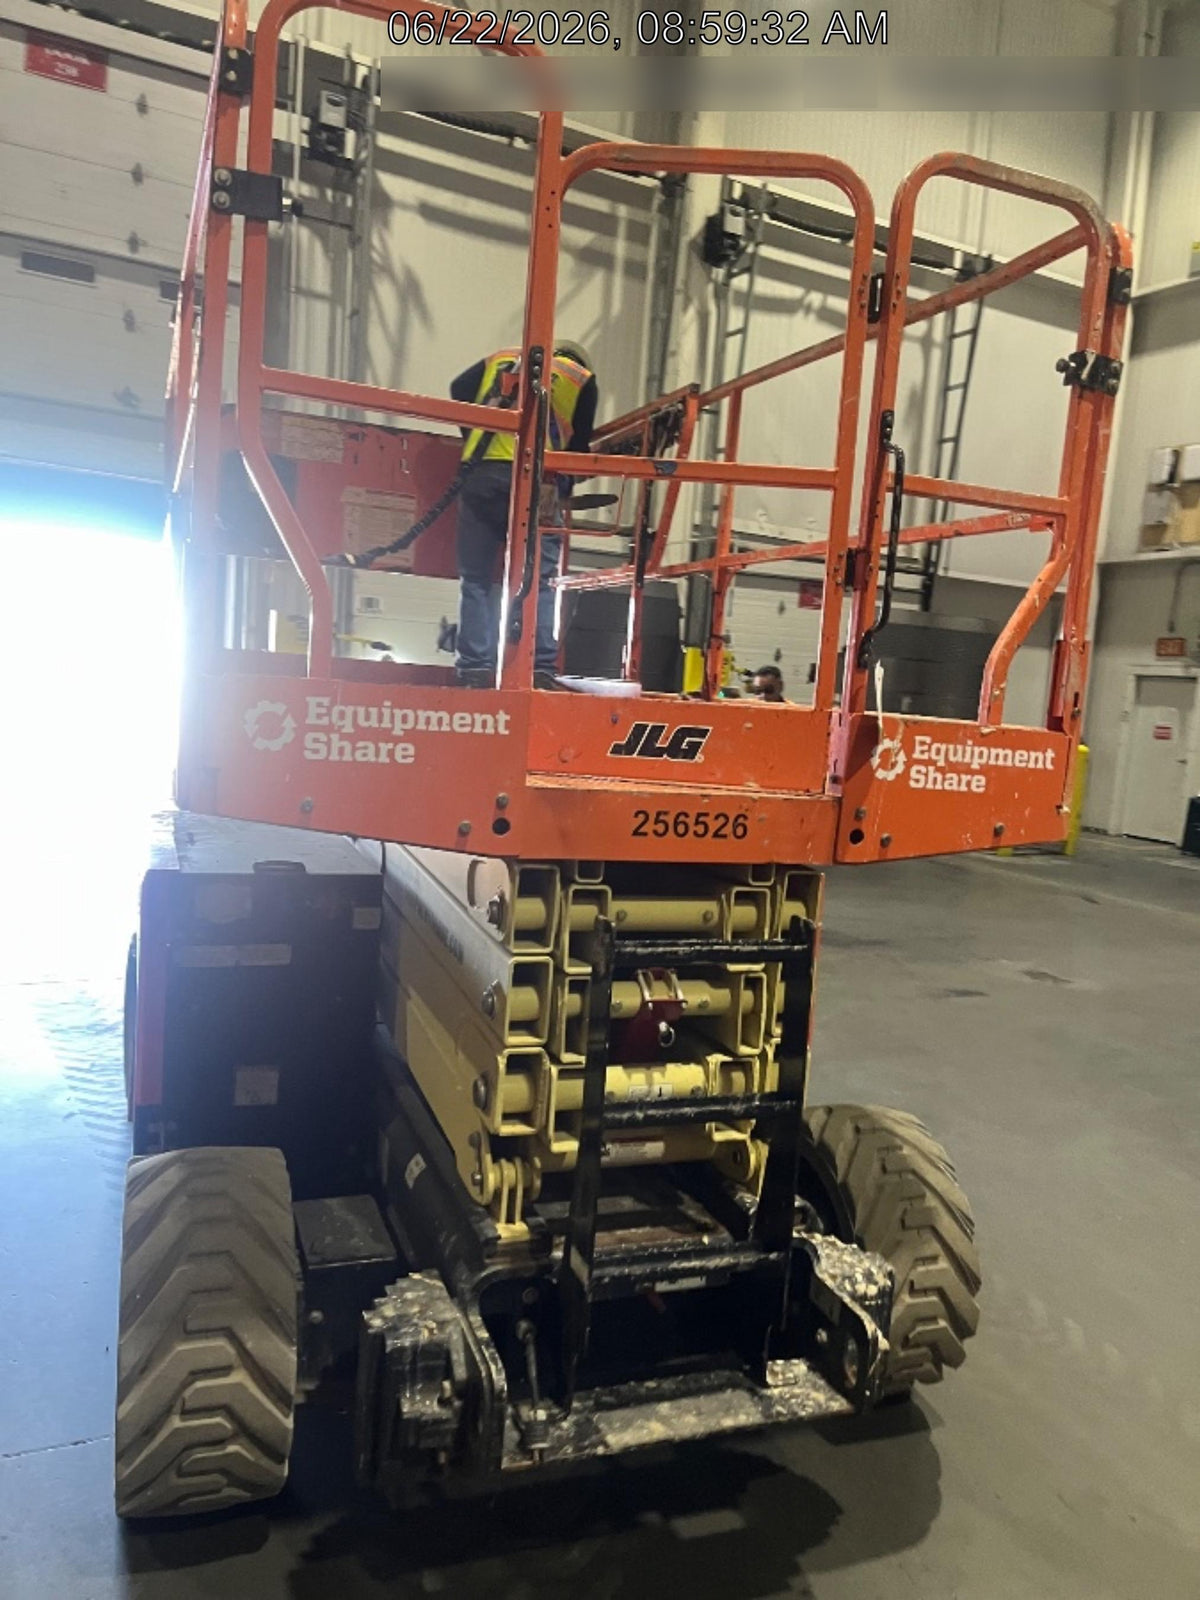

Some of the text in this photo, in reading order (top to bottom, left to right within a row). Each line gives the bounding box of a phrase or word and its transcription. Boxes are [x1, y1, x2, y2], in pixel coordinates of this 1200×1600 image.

[305, 696, 510, 736] Equipment
[304, 731, 415, 763] Share
[607, 721, 713, 762] JLG
[912, 735, 1056, 770] Equipment
[909, 764, 986, 793] Share
[631, 809, 749, 840] 256526
